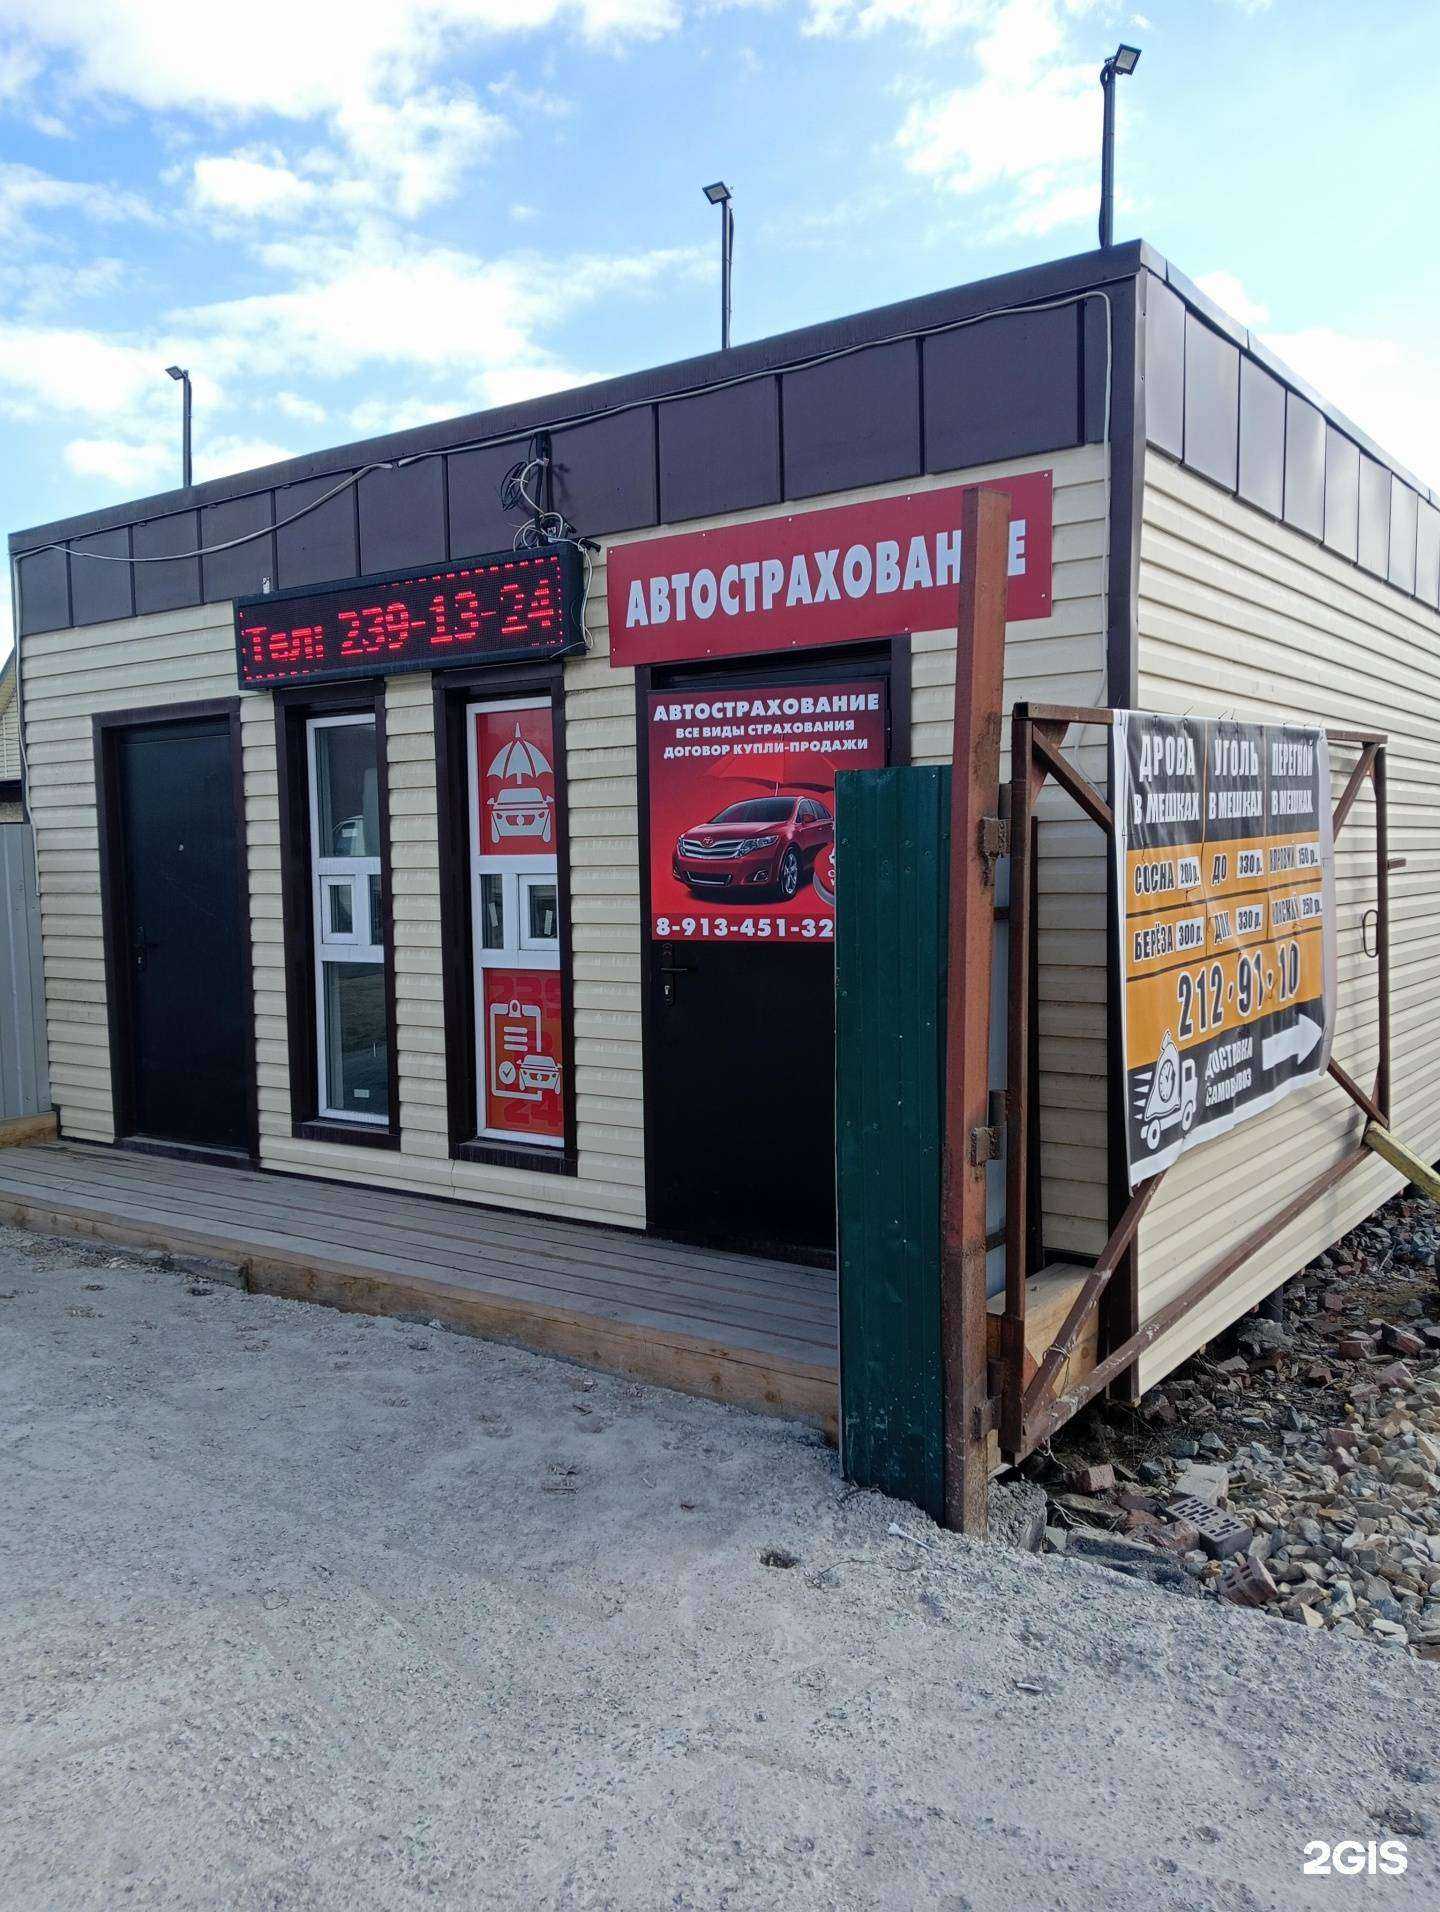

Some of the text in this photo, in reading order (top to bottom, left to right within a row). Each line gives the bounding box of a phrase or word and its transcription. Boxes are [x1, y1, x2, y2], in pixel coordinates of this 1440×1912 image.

[626, 518, 1027, 628] АВТОСТРАХОВАНЕ
[339, 580, 555, 655] 239-13-24
[653, 694, 879, 721] АВТОСТРАХОВАНИЕ
[676, 720, 855, 739] ВСЕ ВИДЫ СТРАХОВАНИЯ
[663, 739, 868, 759] ДОГОВОР КУПЛИ-ПРОДАЖИ
[1139, 735, 1195, 782] ДРОВА
[1214, 738, 1259, 776] УГОЛЬ
[1271, 742, 1314, 776] ПЕРЕГНОЙ
[1133, 792, 1200, 824] В МЕШКАХ
[1209, 791, 1263, 820] В МЕШКАХ
[1271, 790, 1279, 815] В
[1134, 861, 1175, 895] СОСНА
[1180, 863, 1192, 884] 200
[1212, 855, 1227, 885] ДО
[1239, 855, 1254, 874] 330
[1238, 909, 1253, 931] 330
[1134, 923, 1174, 960] БЕРЁЗА
[1179, 923, 1195, 946] 300
